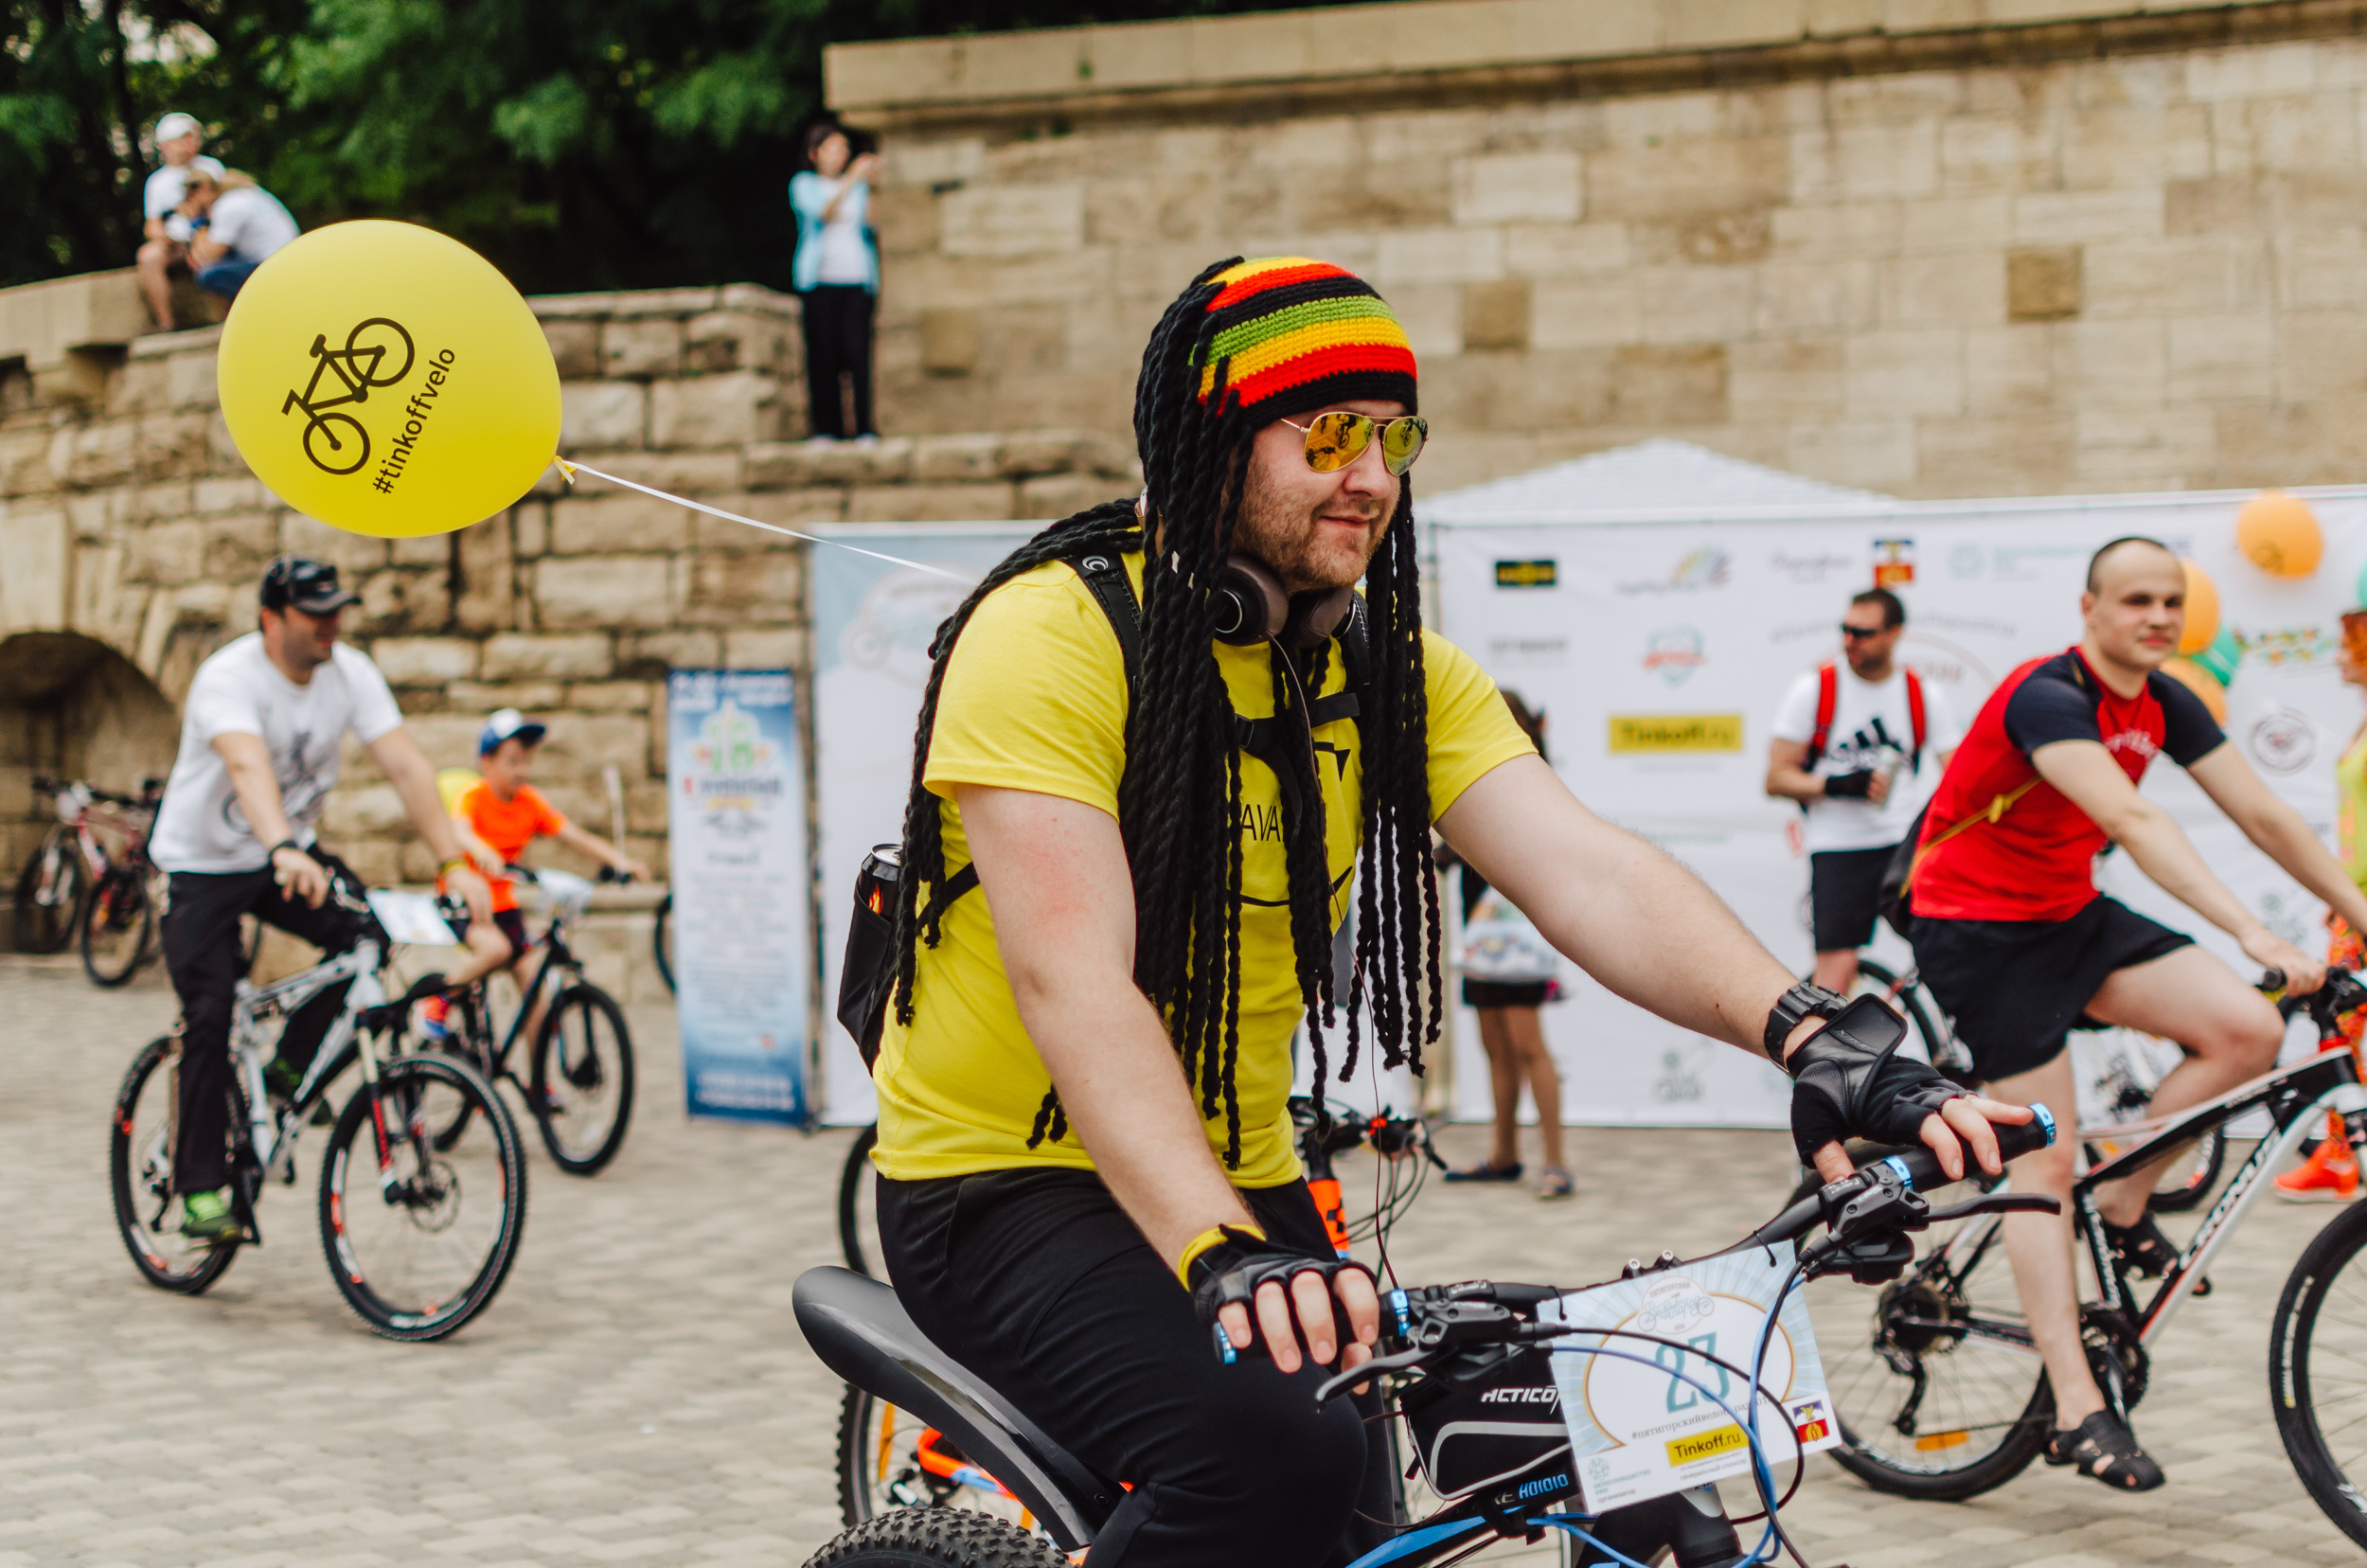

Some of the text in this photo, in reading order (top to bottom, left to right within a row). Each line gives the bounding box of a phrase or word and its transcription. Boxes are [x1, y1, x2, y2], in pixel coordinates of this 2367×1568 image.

[372, 348, 454, 494] #tinkoffvelo
[1655, 1331, 1731, 1414] 23
[1674, 1432, 1741, 1458] Tinkoff.ru
[1680, 1465, 1721, 1481] генеральный
[1721, 1458, 1748, 1471] спонсор
